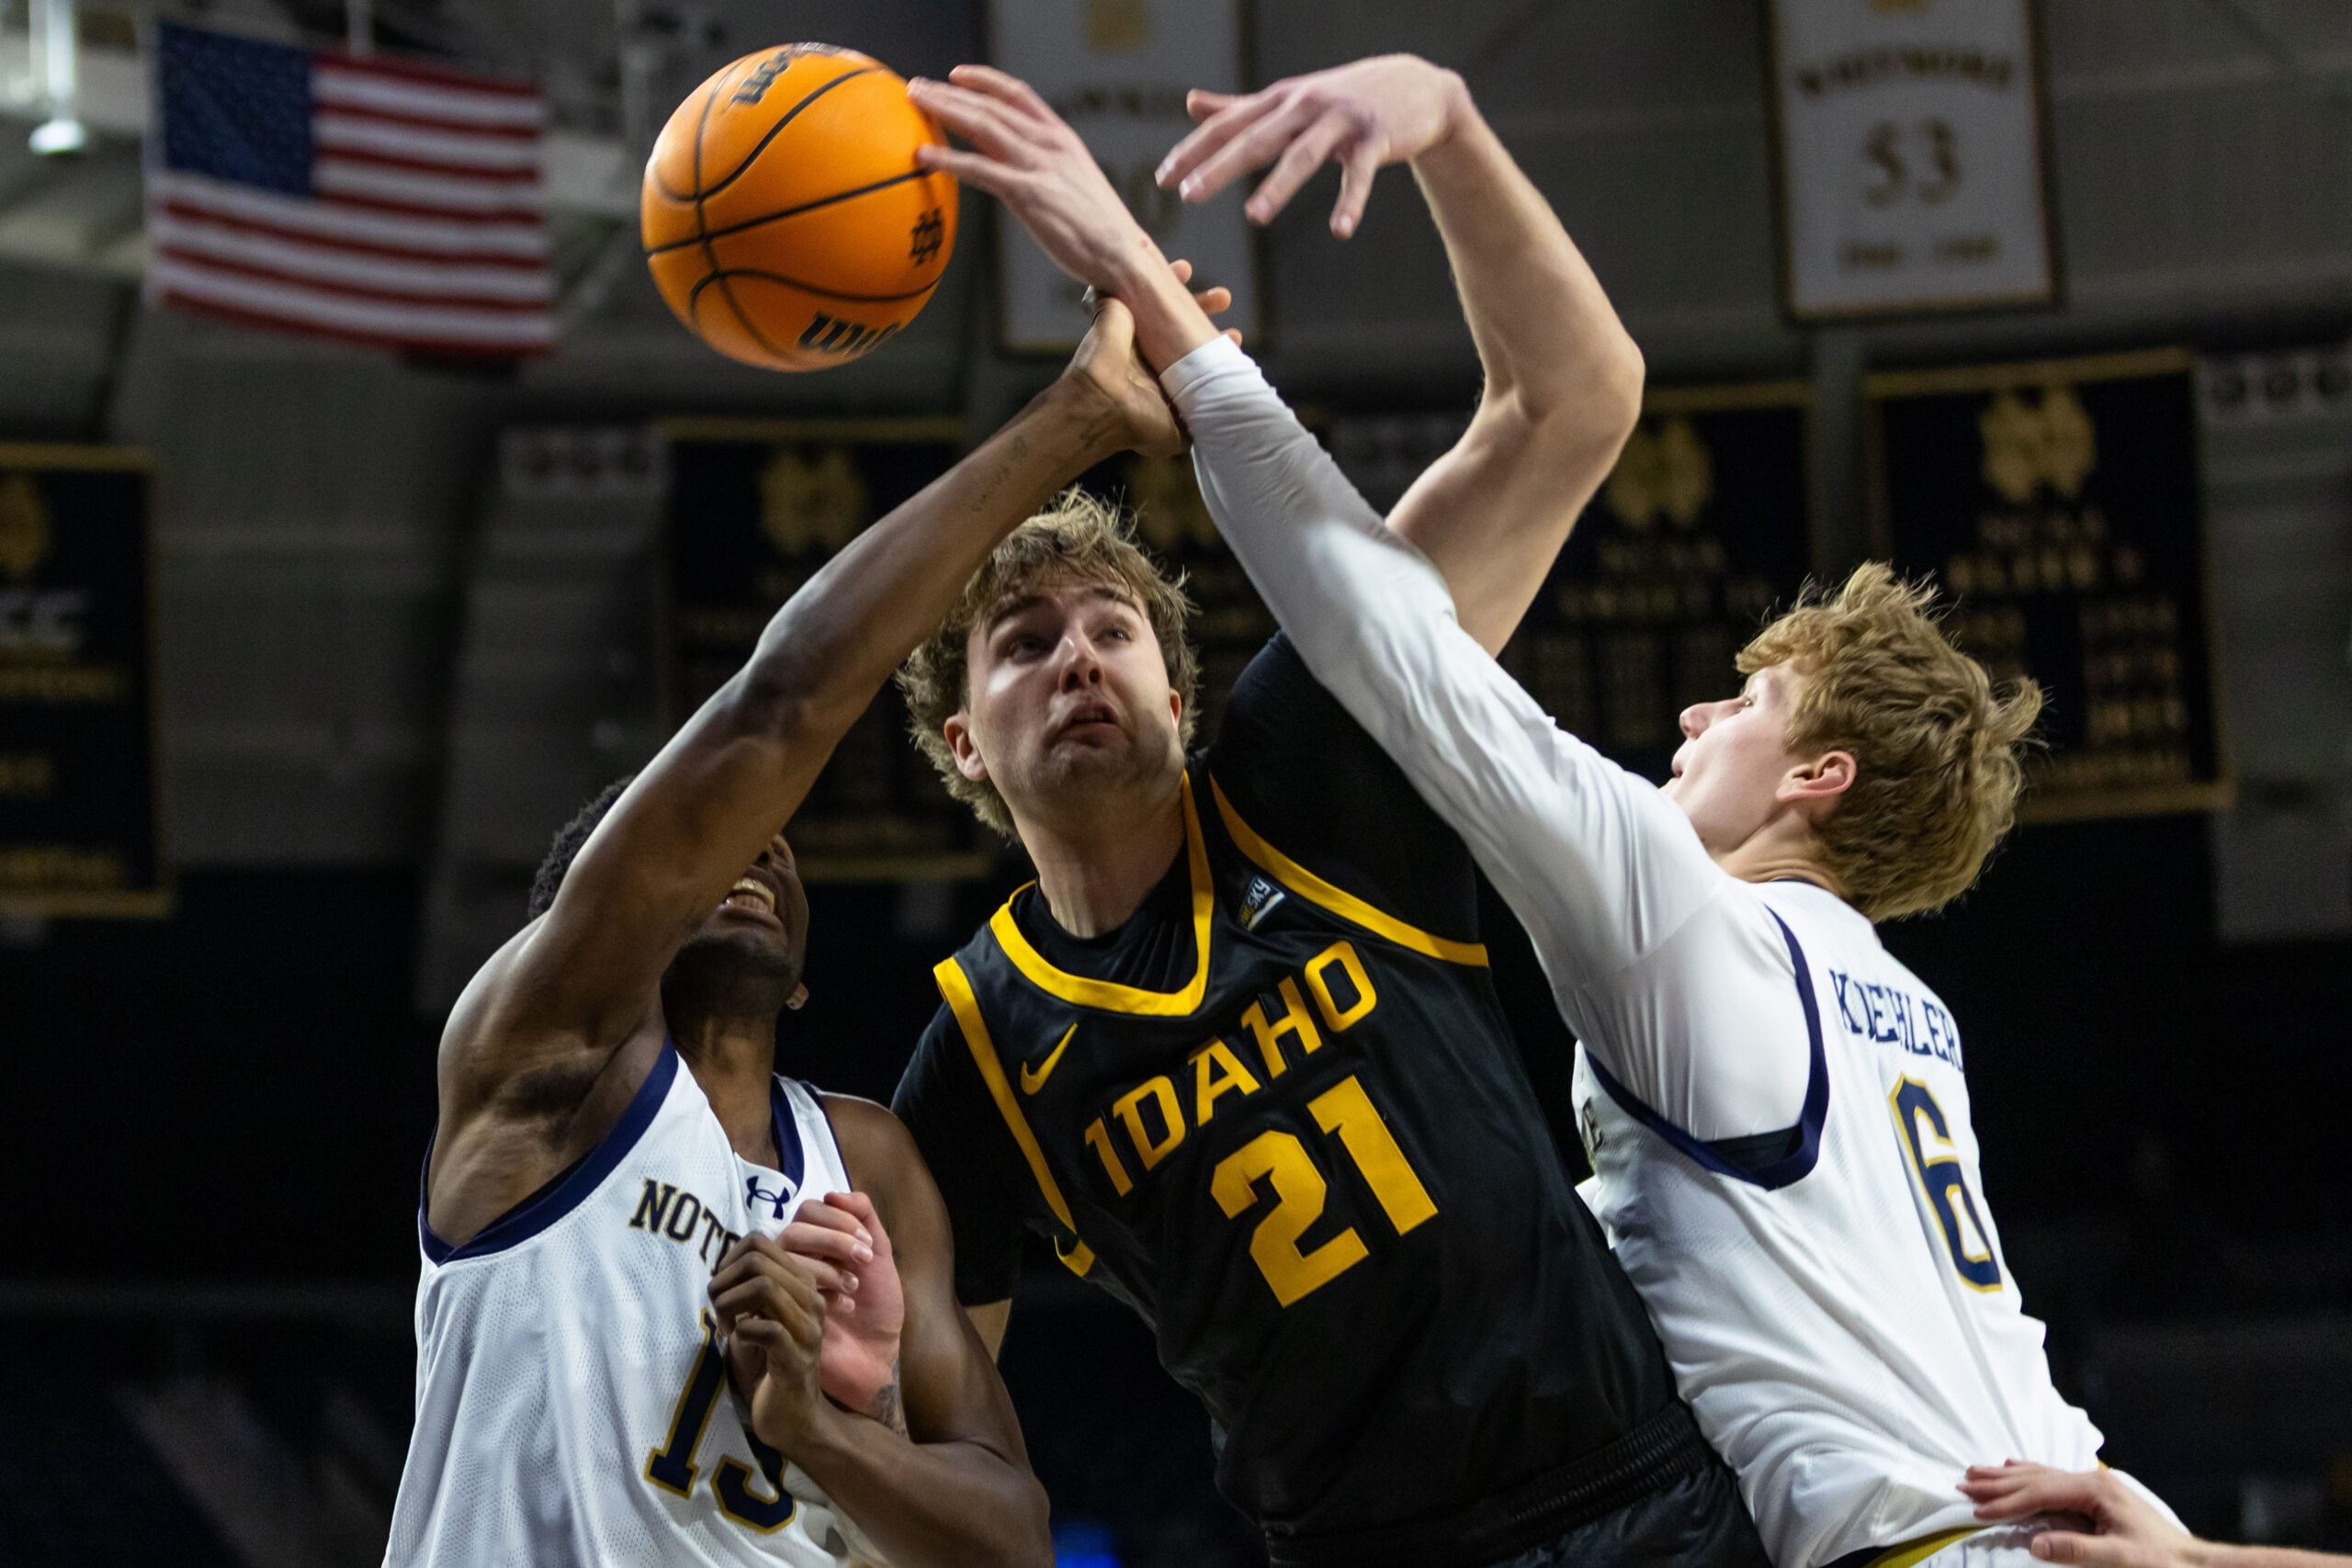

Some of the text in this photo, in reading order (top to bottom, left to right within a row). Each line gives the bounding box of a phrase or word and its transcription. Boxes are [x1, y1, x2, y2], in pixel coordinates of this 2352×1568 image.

[1863, 119, 1961, 208] 53
[1085, 940, 1377, 1197] IDAHO
[1210, 1075, 1439, 1308] 21
[1889, 1072, 2004, 1293] 6
